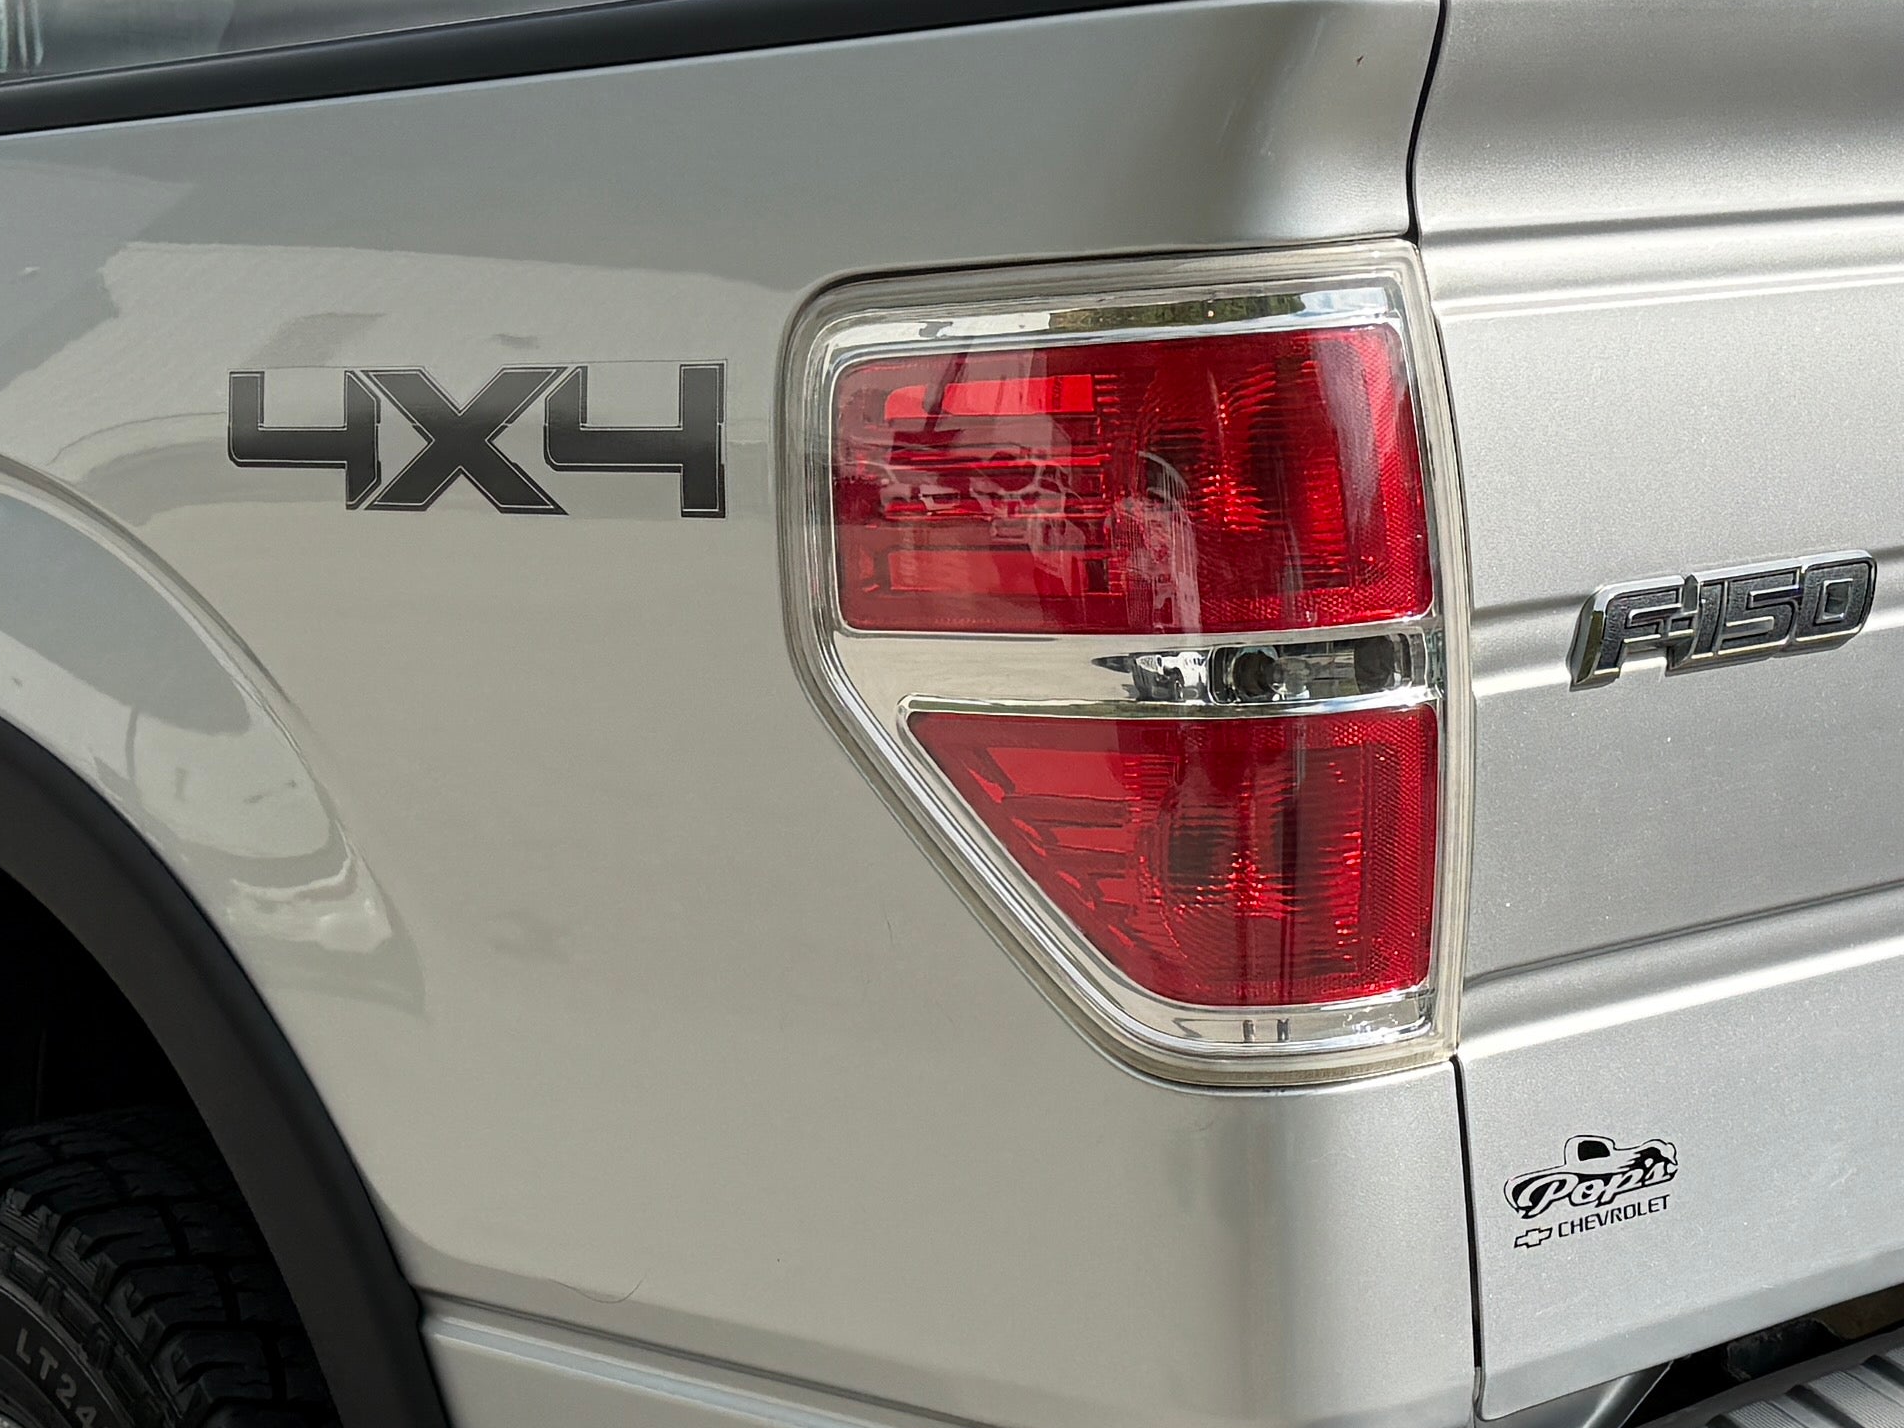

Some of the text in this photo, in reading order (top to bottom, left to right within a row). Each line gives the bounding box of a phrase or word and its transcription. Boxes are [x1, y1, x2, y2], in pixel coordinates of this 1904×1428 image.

[227, 360, 727, 518] 4X4
[1567, 549, 1877, 691] F-150
[1516, 1158, 1672, 1219] Pop's
[1558, 1194, 1670, 1237] CHEVROLET
